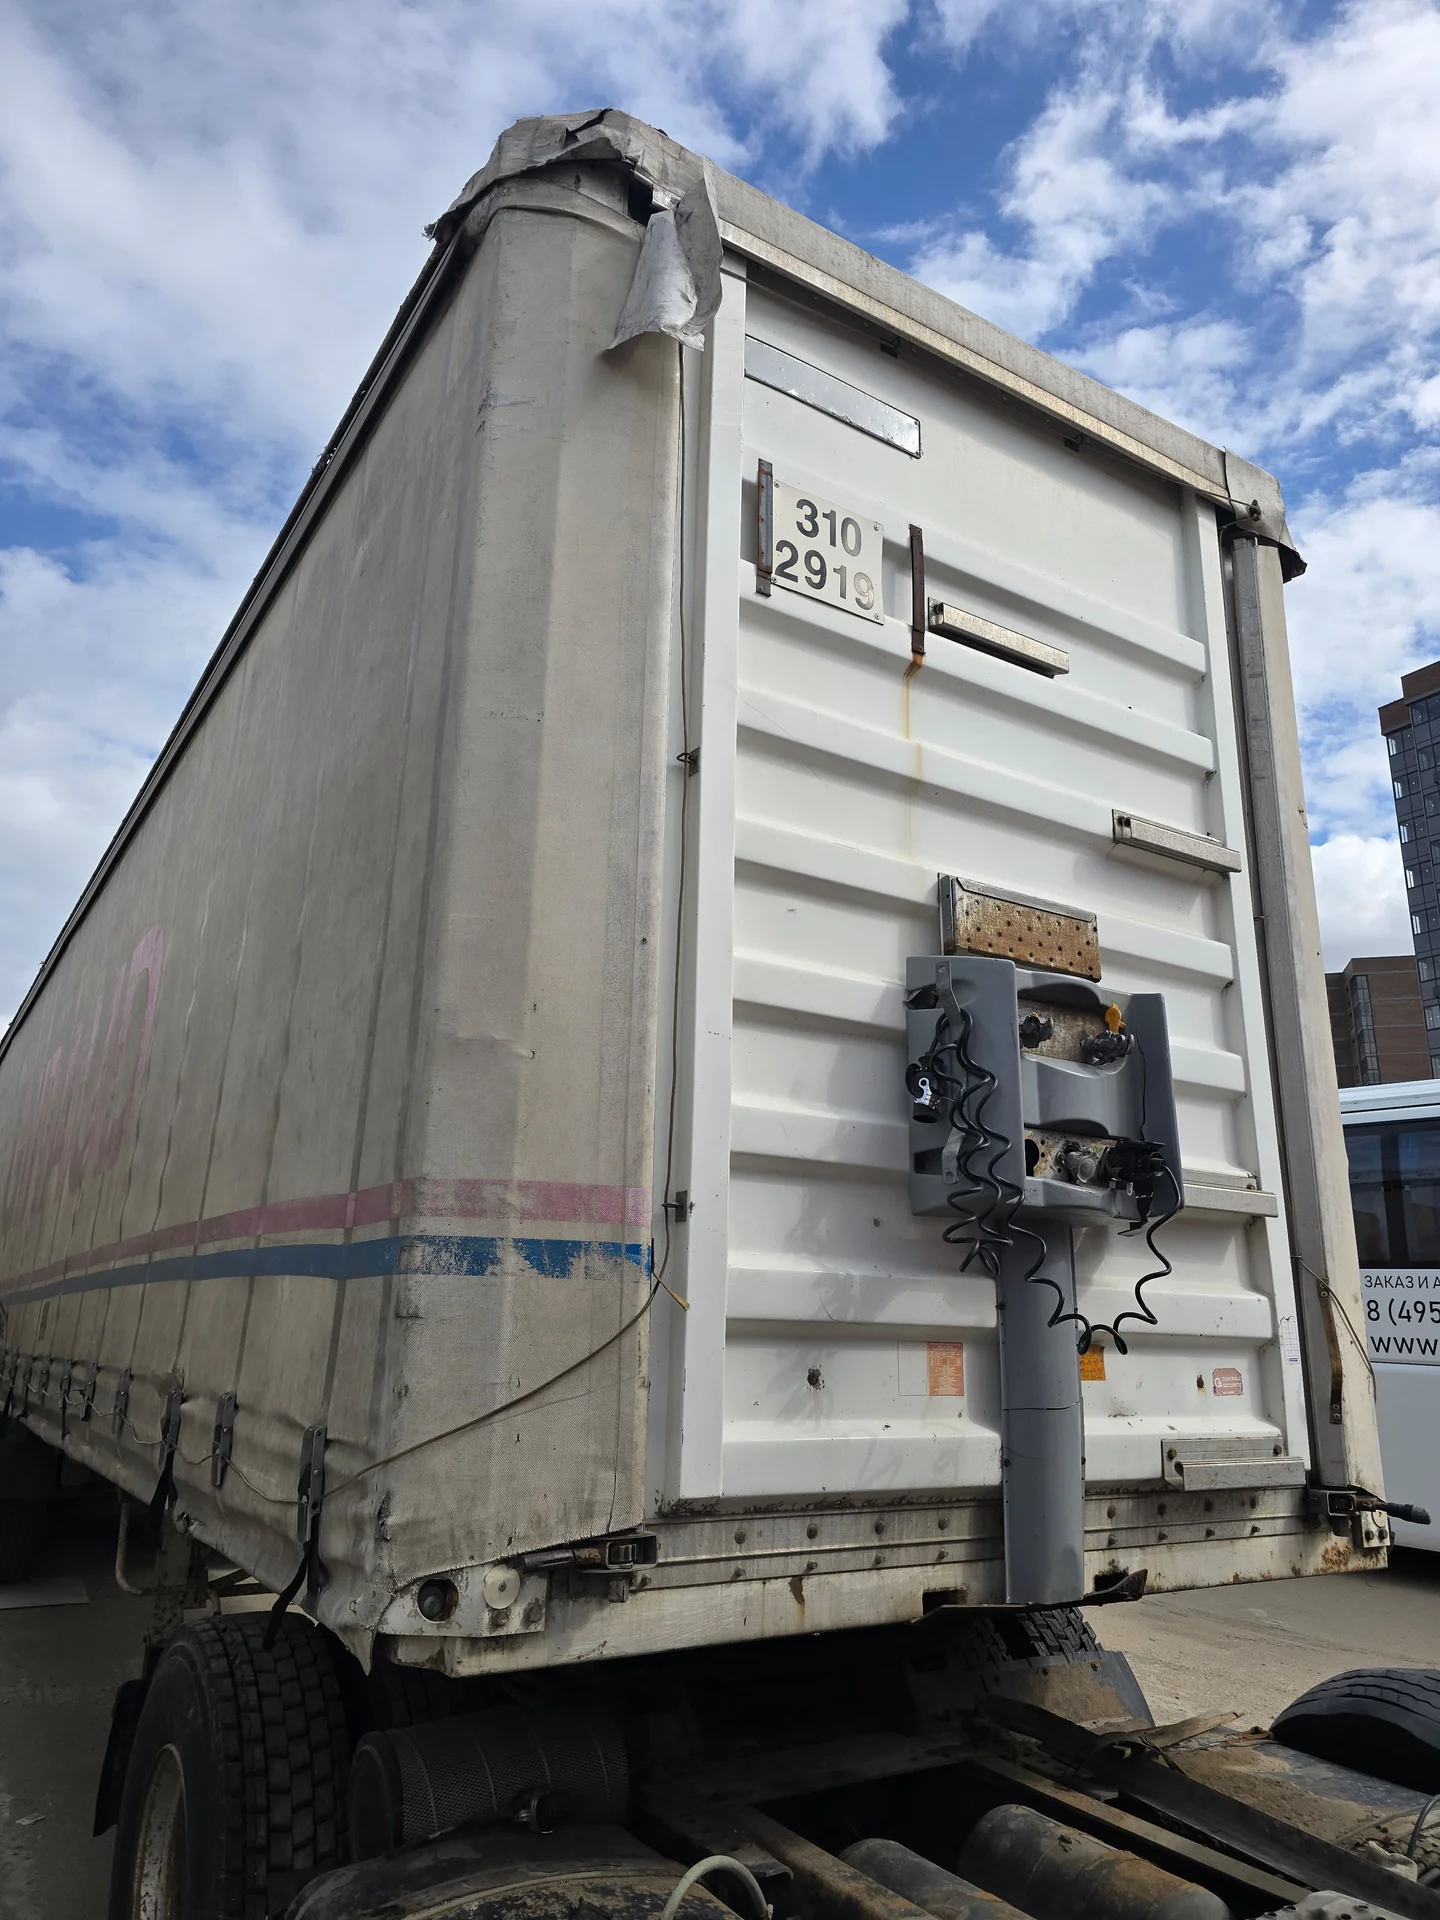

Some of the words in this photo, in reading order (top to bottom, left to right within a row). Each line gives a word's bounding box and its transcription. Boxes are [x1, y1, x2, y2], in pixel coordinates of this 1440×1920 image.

[796, 498, 862, 557] 310
[774, 539, 875, 611] 2919
[1364, 1275, 1414, 1289] ЗАКАЗ
[1418, 1275, 1429, 1289] И
[1366, 1299, 1380, 1322] 8
[1388, 1298, 1440, 1327] (495
